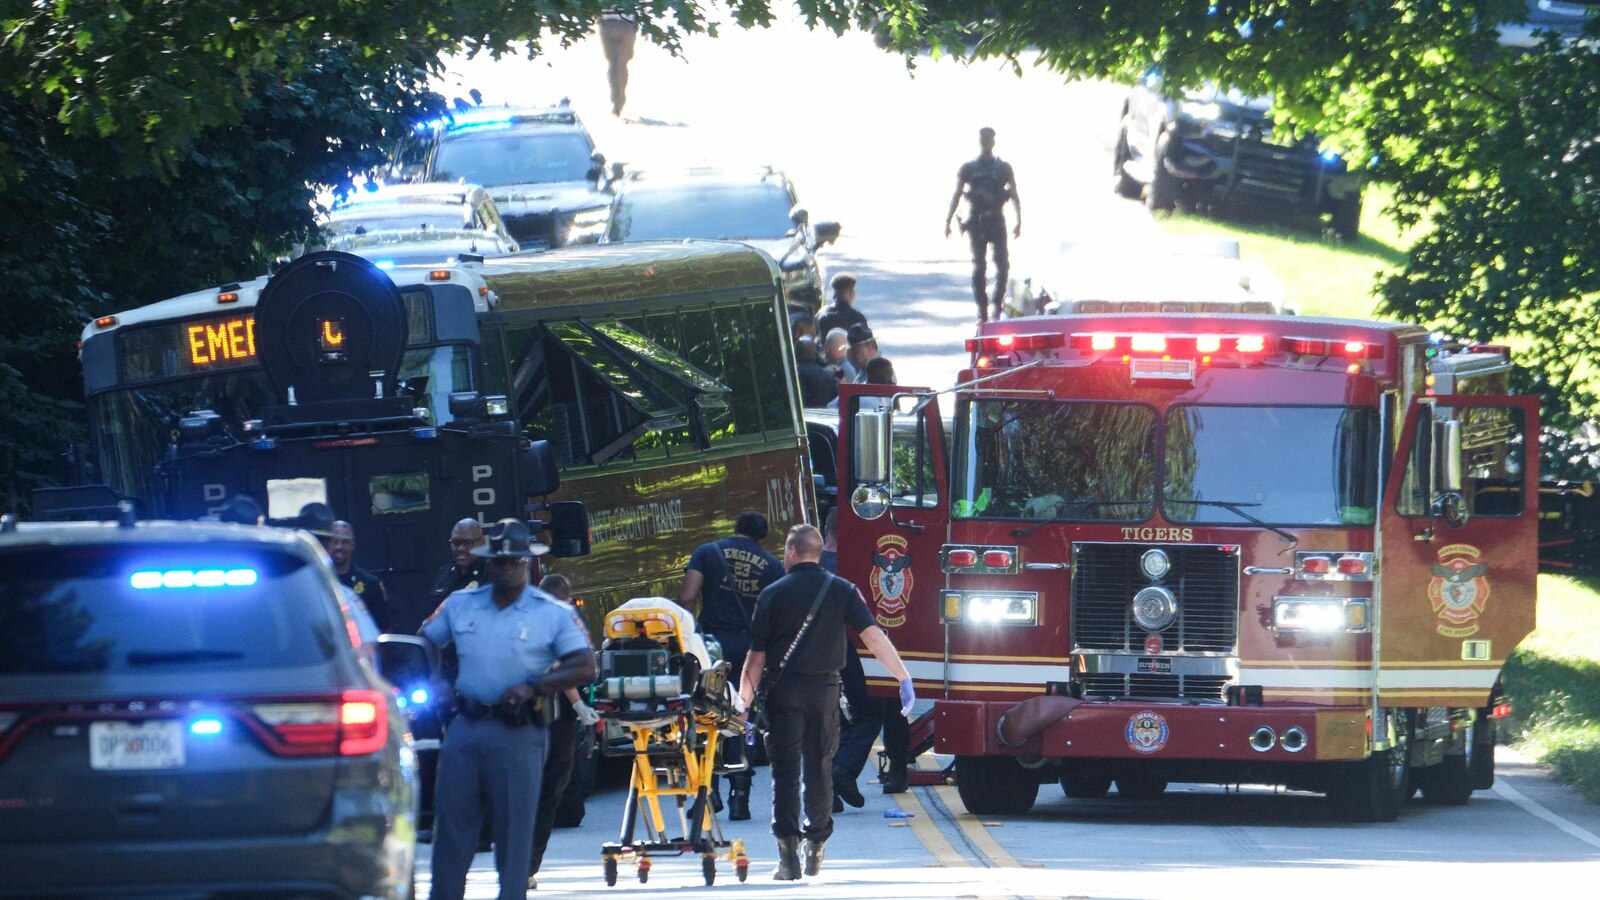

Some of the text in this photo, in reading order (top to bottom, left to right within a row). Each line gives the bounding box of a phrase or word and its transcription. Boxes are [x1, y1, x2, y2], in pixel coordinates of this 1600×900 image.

[614, 503, 649, 541] COUNTY
[649, 498, 684, 535] TRANSIT
[893, 536, 906, 545] COUNTY
[1121, 527, 1193, 541] TIGERS
[723, 548, 769, 570] ENGINE
[734, 561, 751, 578] 23
